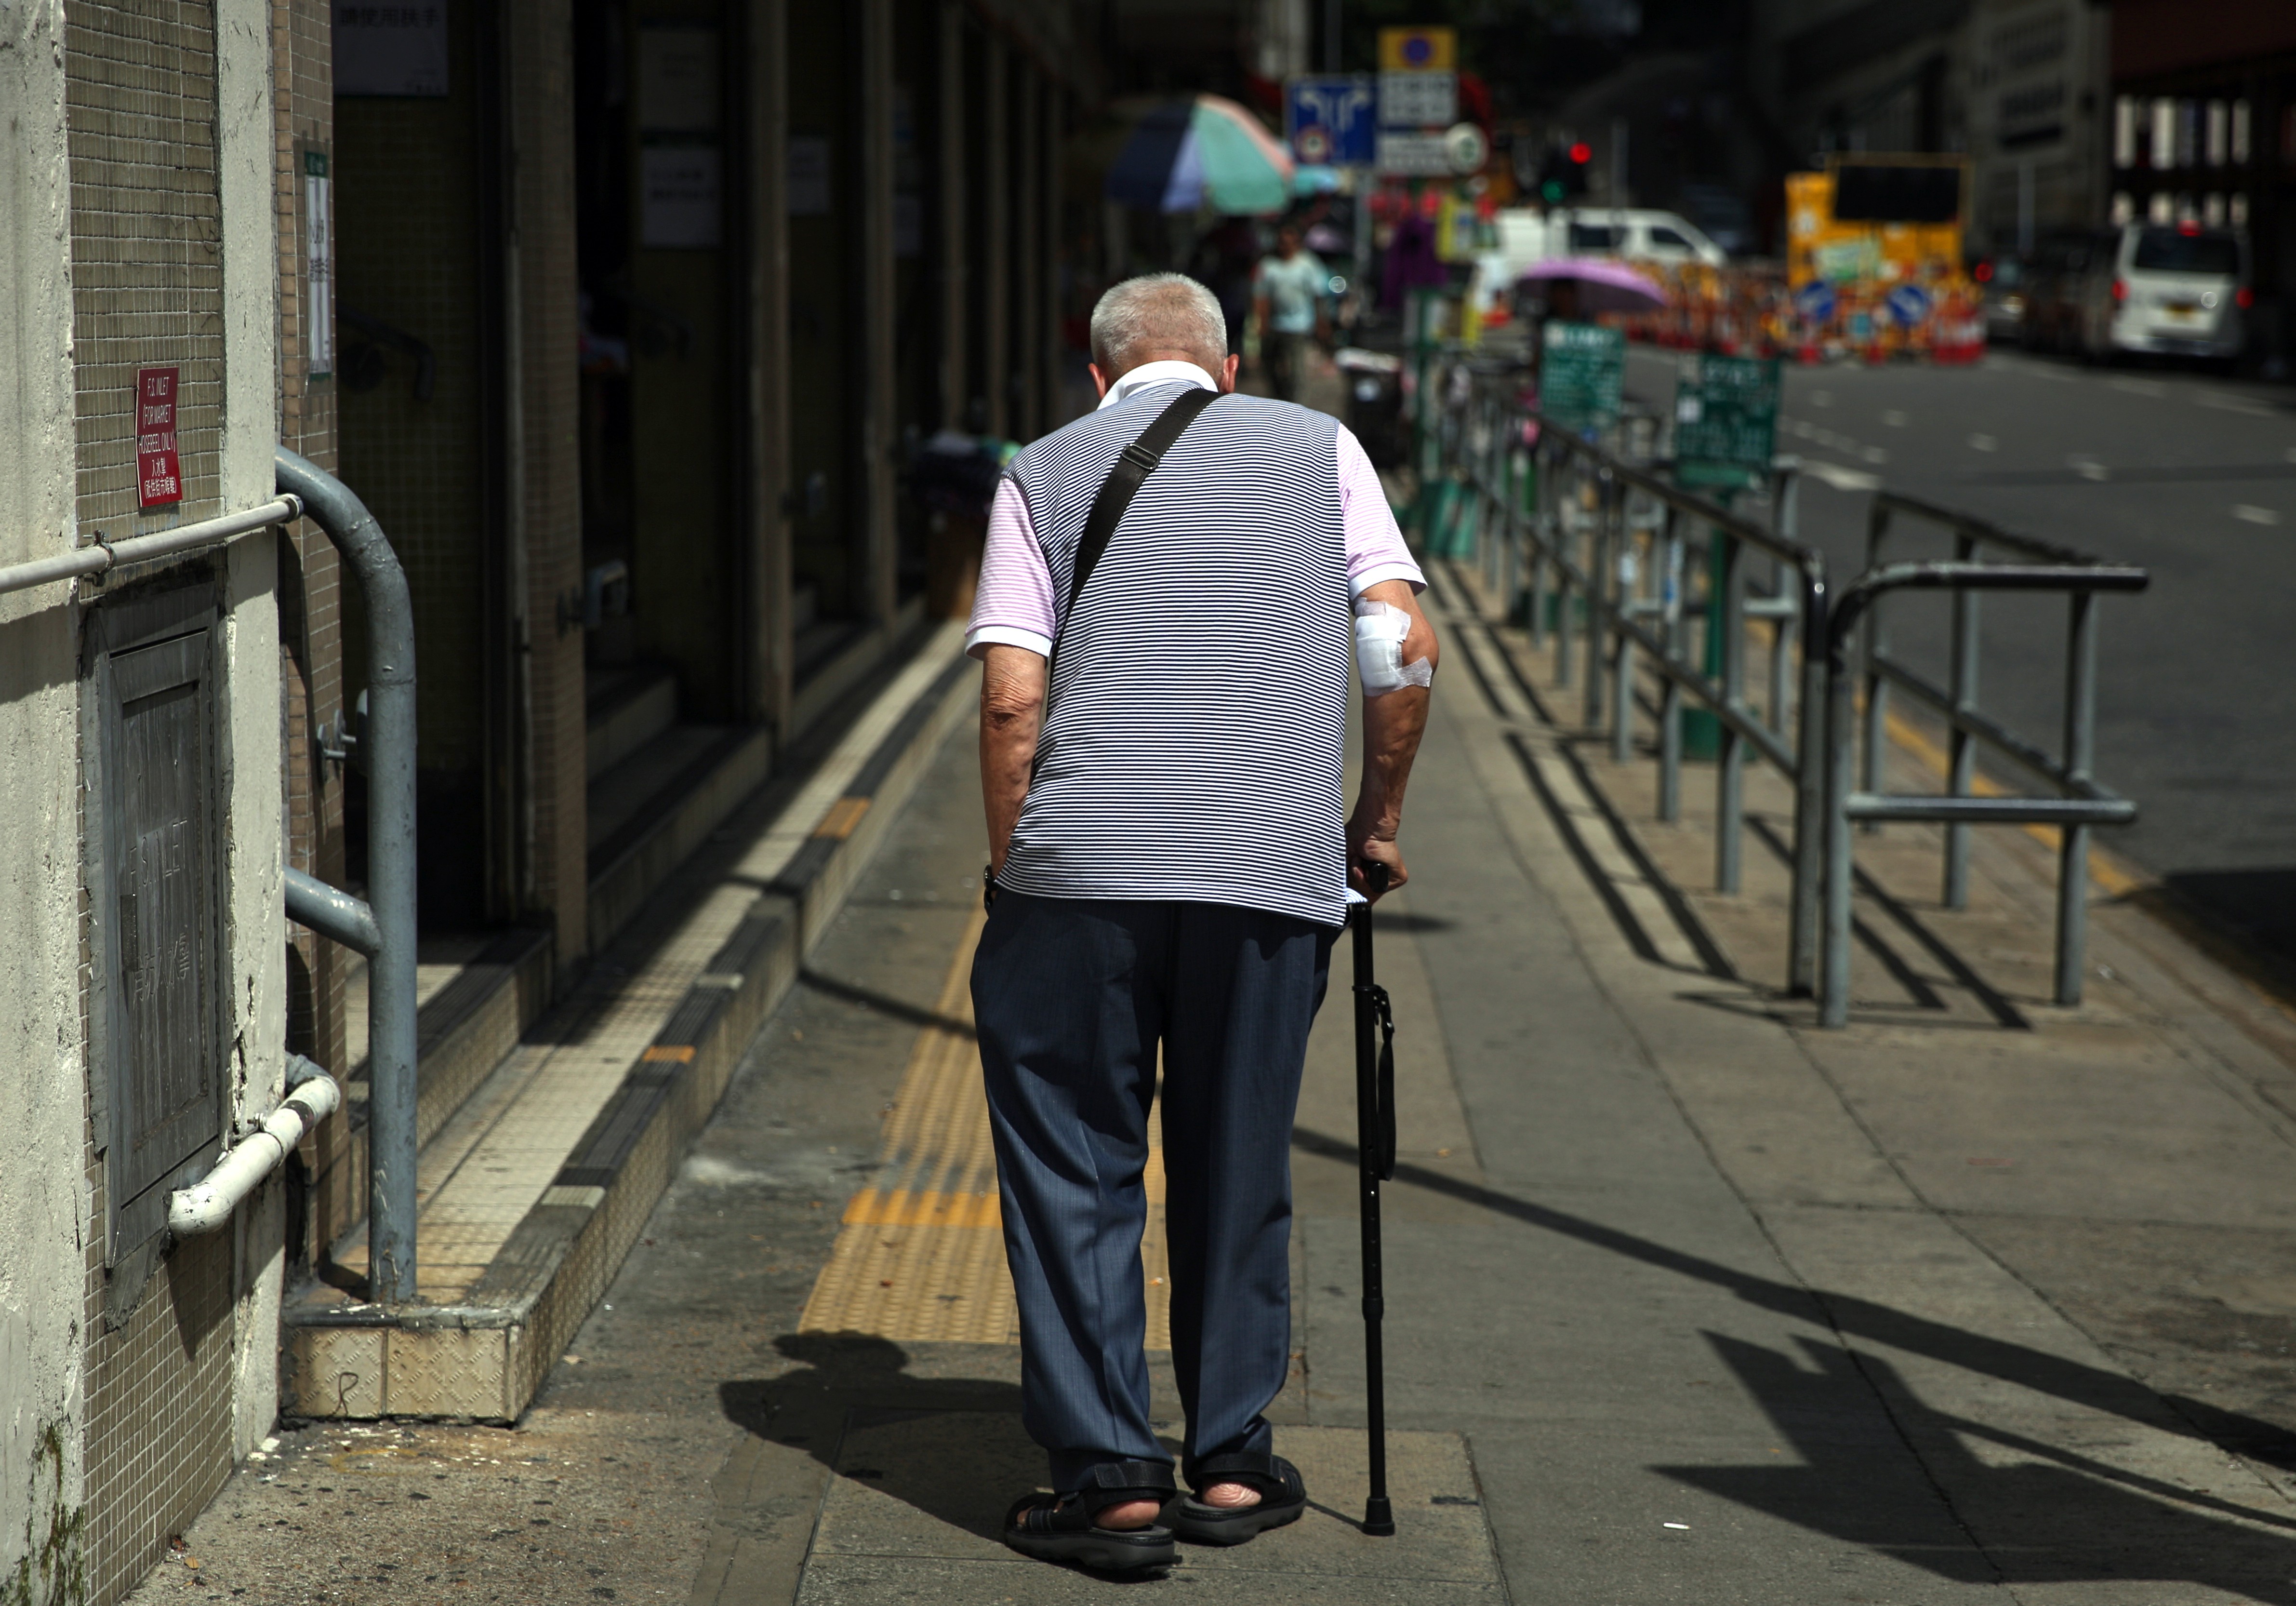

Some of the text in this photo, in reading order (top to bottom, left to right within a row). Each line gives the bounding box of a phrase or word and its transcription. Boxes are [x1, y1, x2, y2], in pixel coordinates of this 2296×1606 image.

[147, 376, 170, 397] F.S. INLET
[143, 403, 172, 429] (FOR MARKET
[138, 428, 176, 454] HOSEREEL ONLY)
[153, 817, 188, 884] INLET
